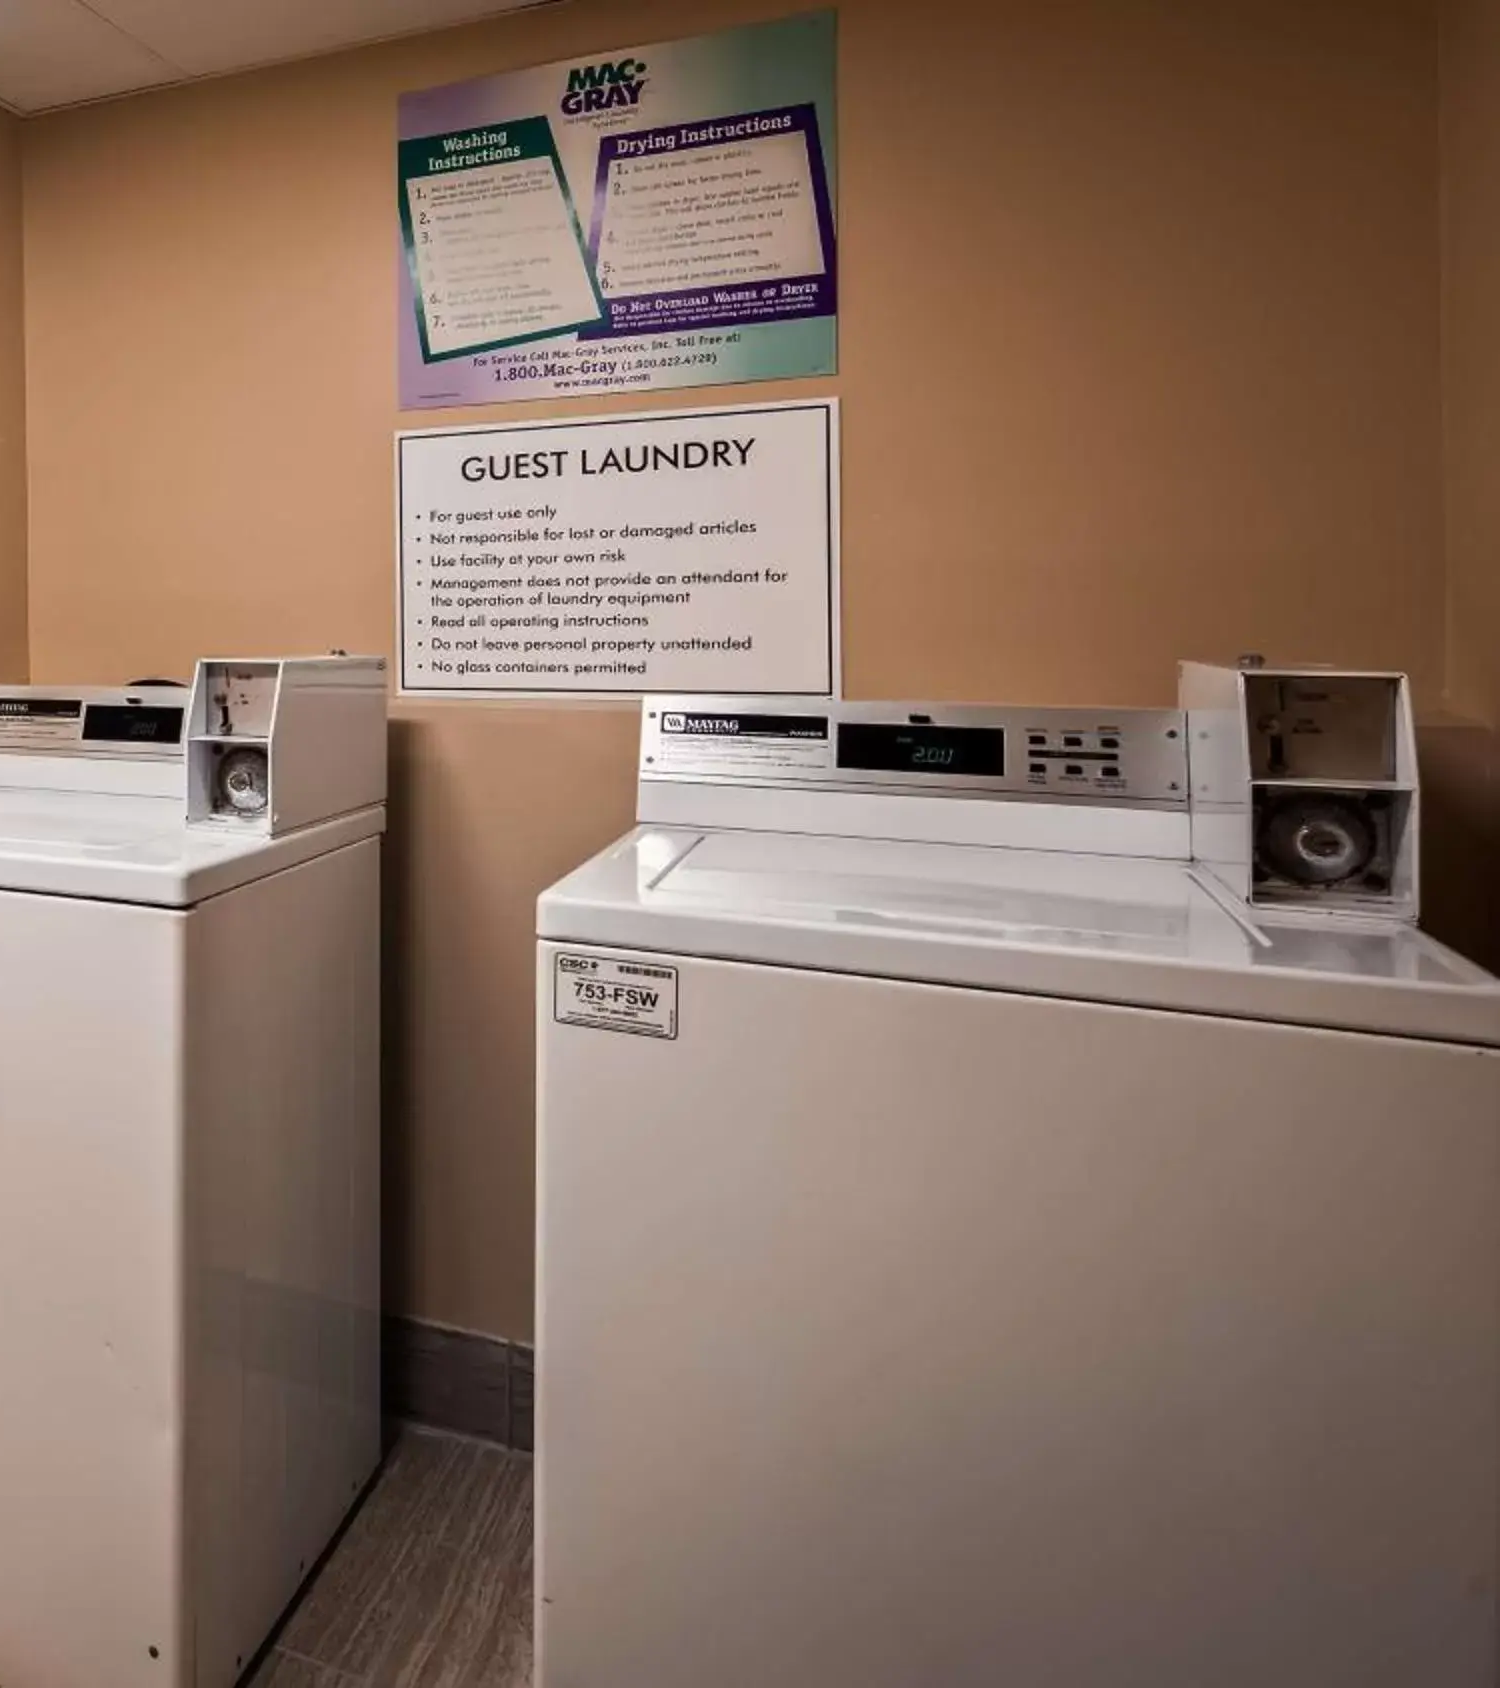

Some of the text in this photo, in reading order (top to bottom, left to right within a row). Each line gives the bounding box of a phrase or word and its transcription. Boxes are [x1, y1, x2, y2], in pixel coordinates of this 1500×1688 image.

[566, 58, 636, 92] MAC
[561, 79, 645, 115] GRAY
[443, 131, 507, 152] Washing
[617, 115, 792, 155] Drying Instructions
[427, 146, 521, 171] Instructions
[419, 211, 431, 225] 2.
[491, 354, 527, 365] Service
[530, 352, 549, 361] Call
[676, 336, 695, 347] Toll
[699, 335, 723, 345] Free
[494, 360, 617, 381] 1.800.Mac-Gray
[461, 438, 756, 482] GUEST LAUNDRY
[430, 505, 557, 524] For guest use only
[430, 519, 757, 545] Not responsible for lost or damaged articles
[430, 548, 626, 568] Use facility at your own risk
[430, 567, 788, 592] Management does not provide an attendant for
[431, 591, 691, 608] the operation of laundry equipment
[431, 613, 649, 630] Read all operating instructions
[431, 636, 753, 652] Do not leave personal property unattended
[431, 660, 647, 675] No glass containers permitted
[686, 719, 740, 731] MAYTAG
[573, 981, 659, 1008] 753-FSW
